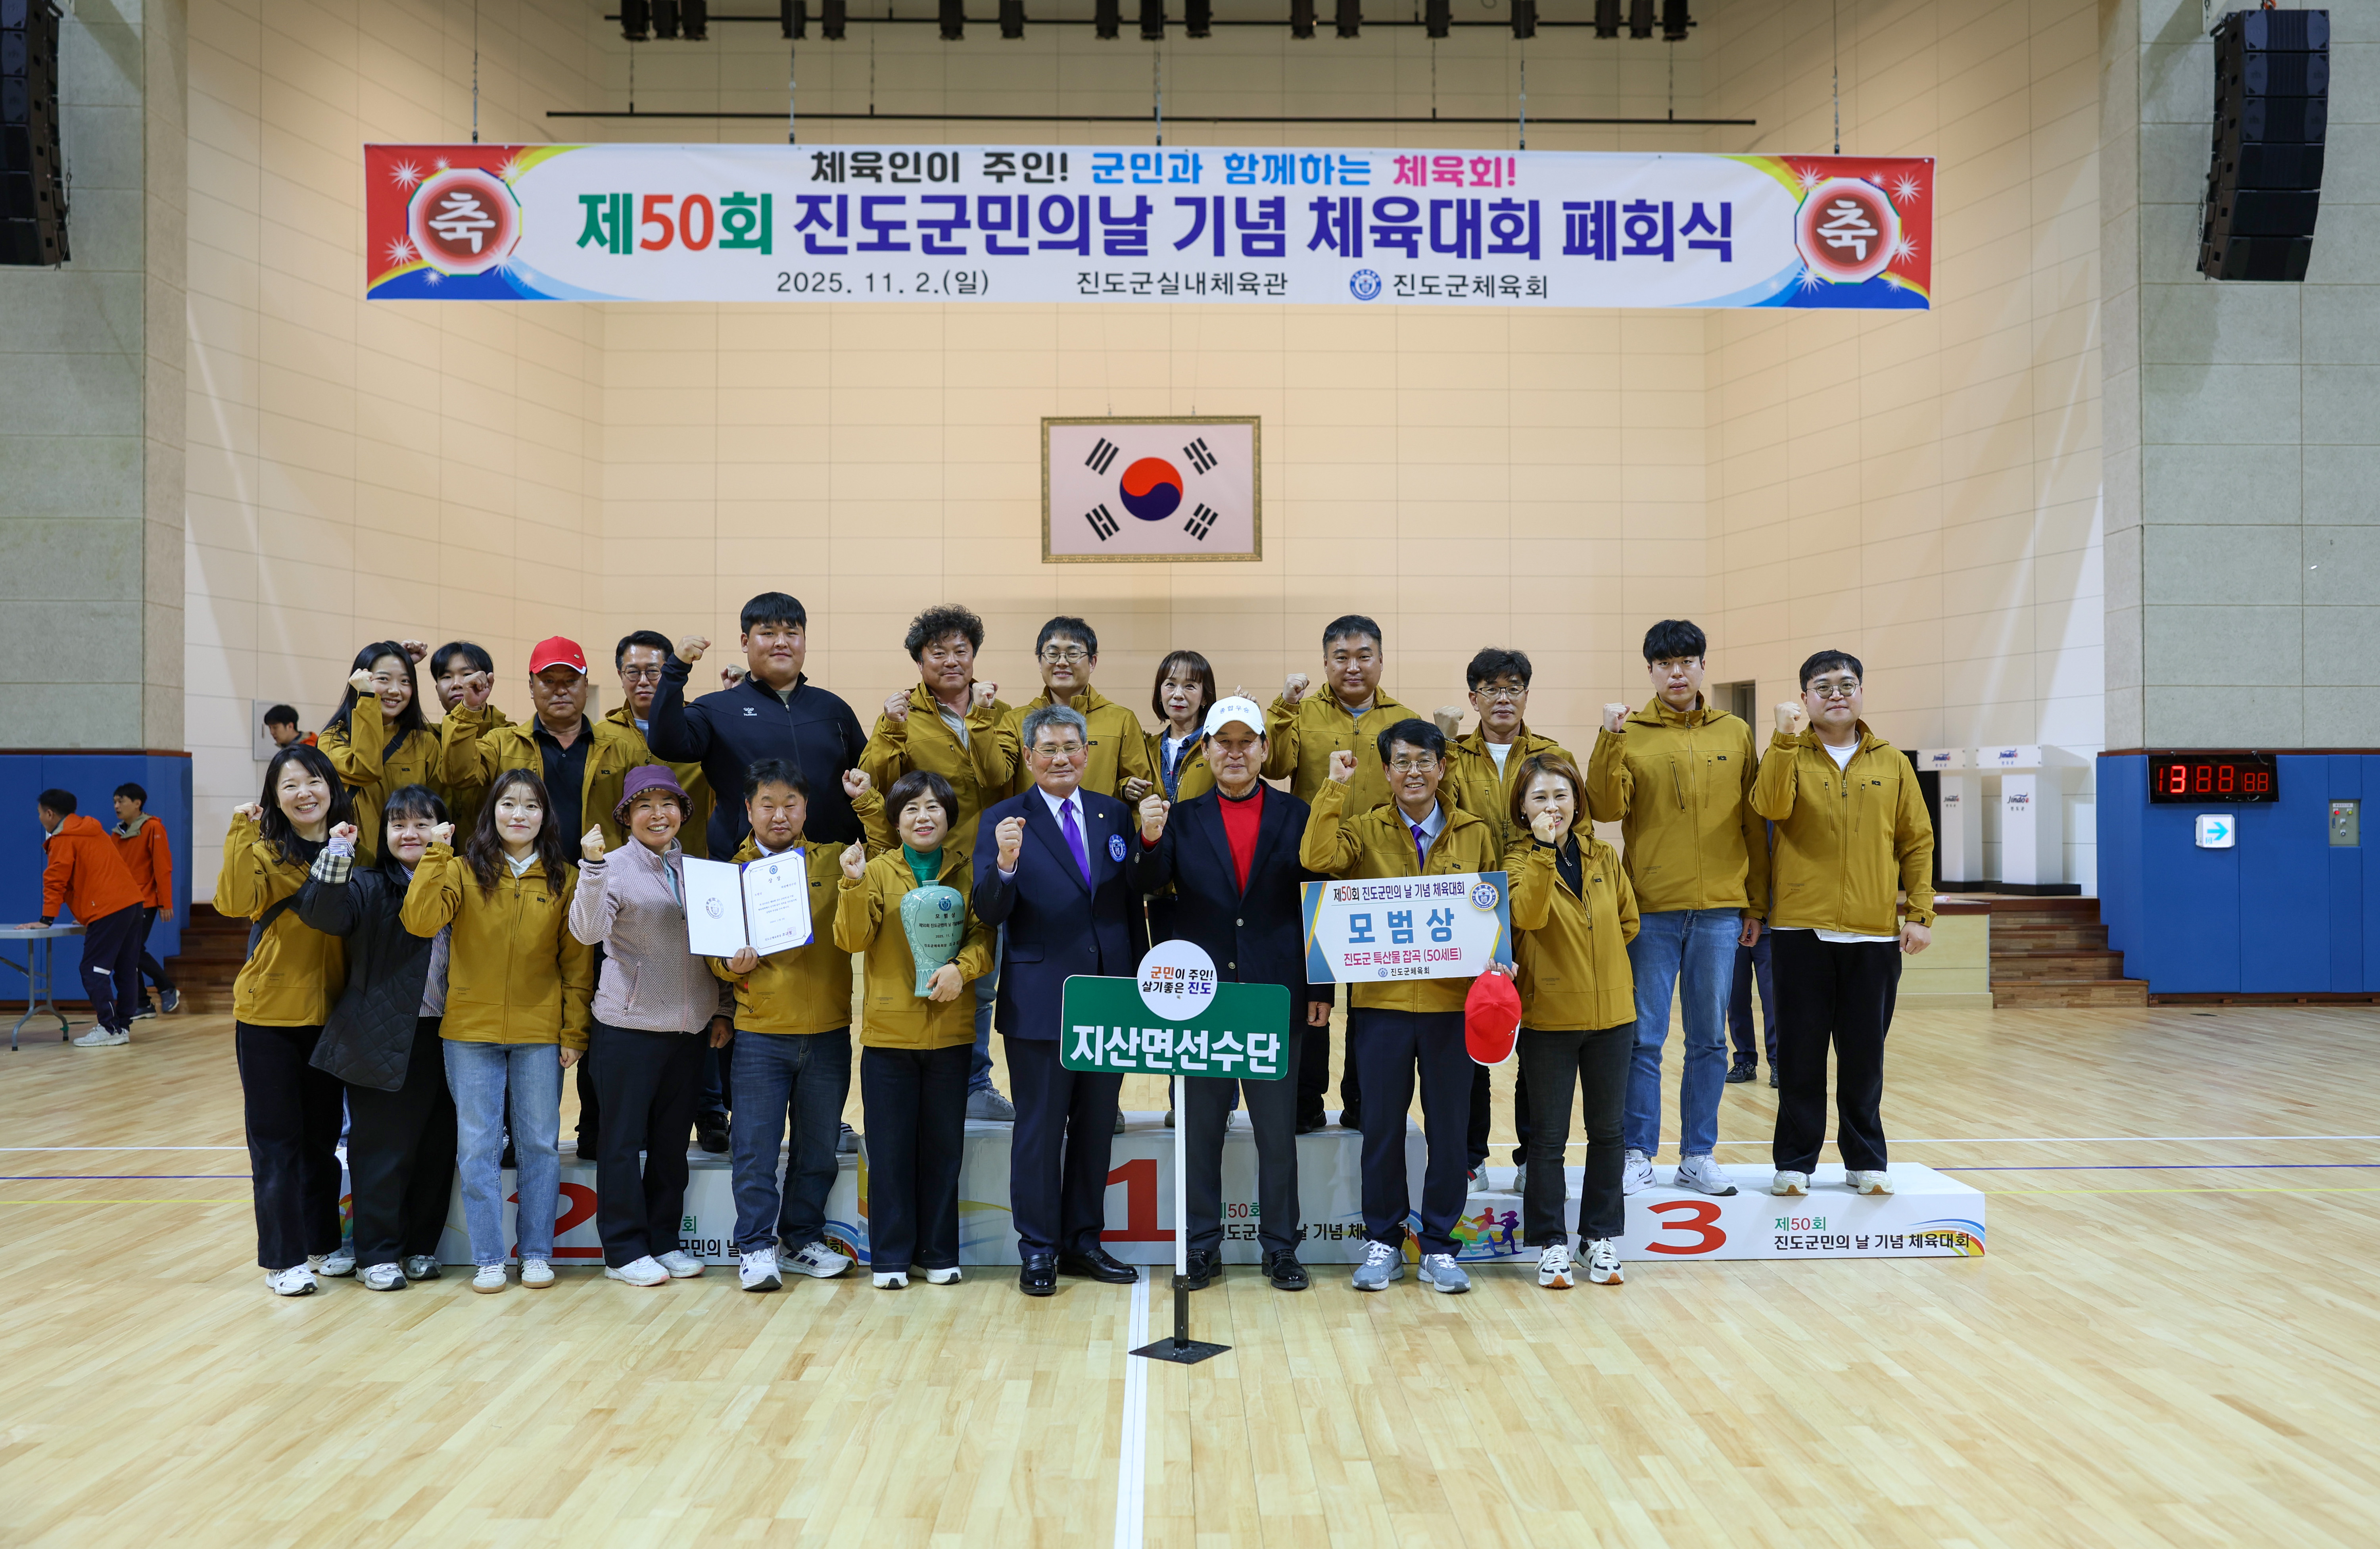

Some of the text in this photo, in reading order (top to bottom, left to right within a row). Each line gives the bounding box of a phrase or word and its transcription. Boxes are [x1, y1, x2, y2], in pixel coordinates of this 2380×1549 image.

[811, 151, 1515, 188] 체육인이 주인! 군민과 함께하는 체육회!
[428, 192, 496, 254] 축
[576, 192, 1732, 262] 제50회 진도군민의날 기념 체육대회 폐회식
[1816, 199, 1878, 261] 축
[777, 270, 988, 295] 2025. 11. 2.(일)
[1077, 271, 1288, 296] 진도군실내체육관
[1393, 274, 1547, 299] 진도군체육회
[1219, 705, 1249, 714] 종합우승
[1333, 881, 1465, 902] 제50회 진도군민의 날 기념 체육대회
[1344, 947, 1462, 966] 진도군 특산물 잡곡 (50세트)
[1151, 966, 1213, 981] 군민이 주인!
[1390, 966, 1430, 976] 진도군체육회
[1142, 981, 1211, 995] 살기좋은 진도
[1070, 1025, 1280, 1074] 지산면선수단
[1100, 1159, 1176, 1242] 1
[1313, 1223, 1342, 1241] 기념
[1645, 1200, 1727, 1255] 3
[1775, 1217, 1826, 1232] 제50회
[1774, 1233, 1970, 1250] 진도군민의 날 기념 체육대회
